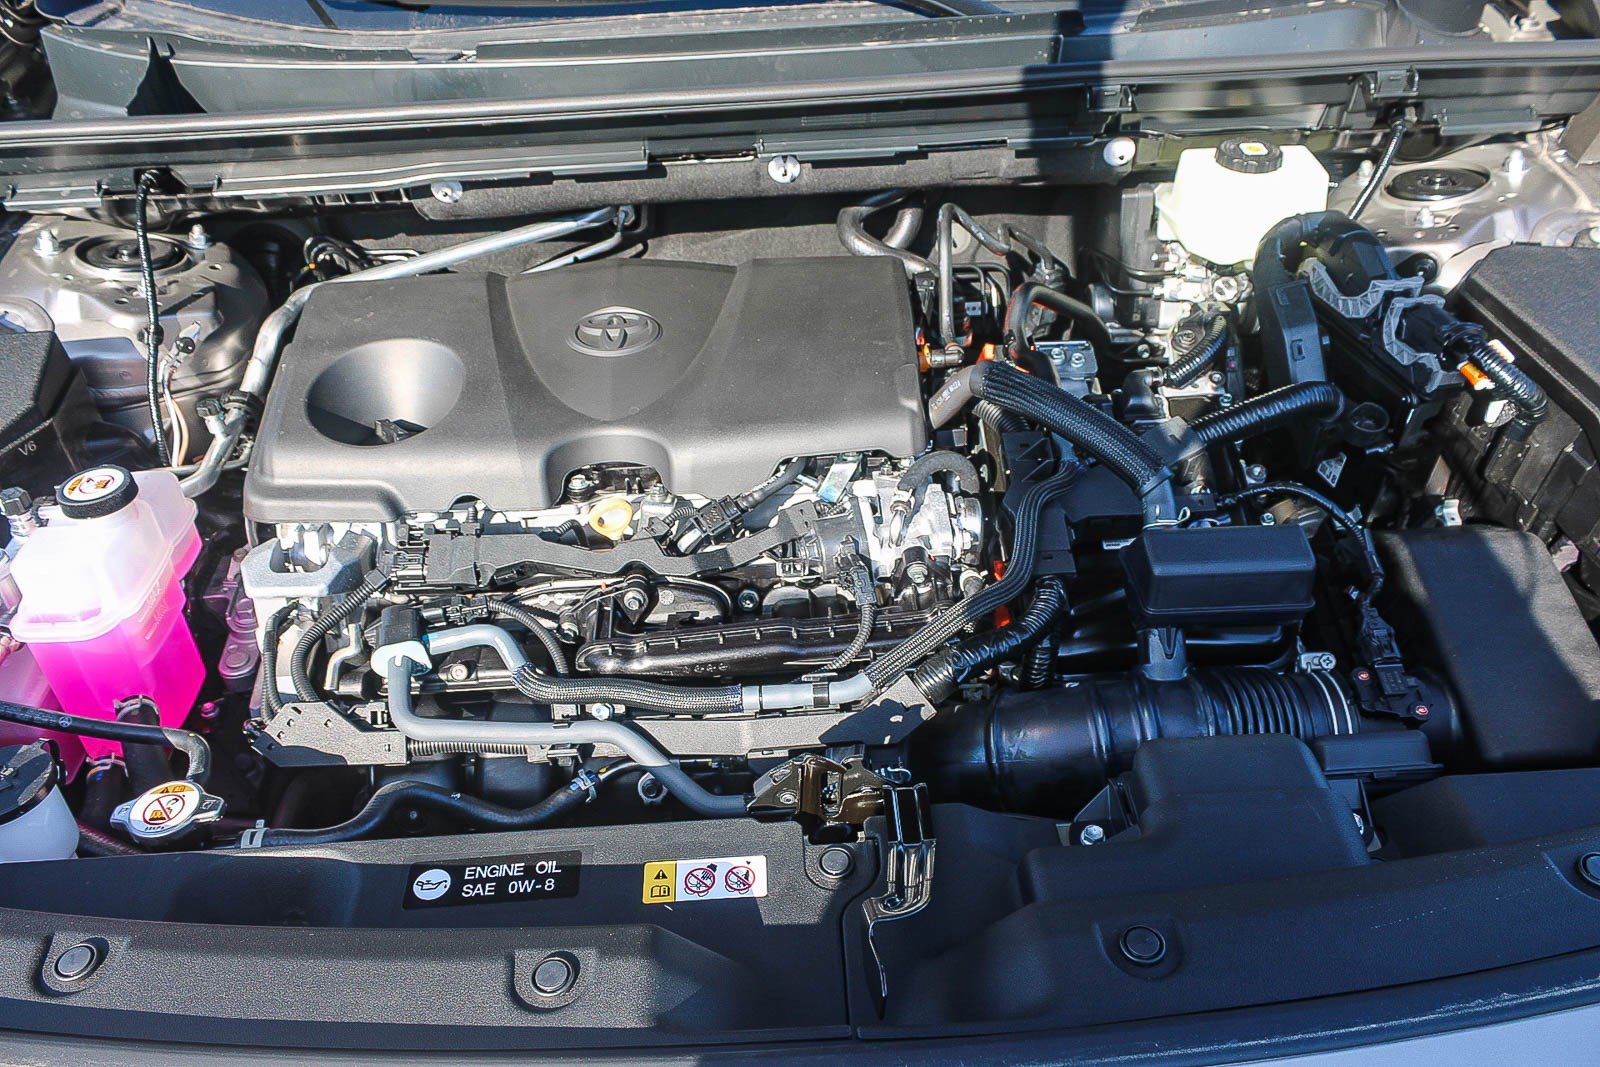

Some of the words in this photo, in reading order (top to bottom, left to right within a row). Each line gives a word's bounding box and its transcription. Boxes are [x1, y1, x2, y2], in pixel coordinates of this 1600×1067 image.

[18, 440, 37, 456] V6
[464, 863, 525, 880] ENGINE
[535, 861, 562, 875] OIL
[462, 882, 497, 898] SAE
[508, 878, 556, 894] 0W-8
